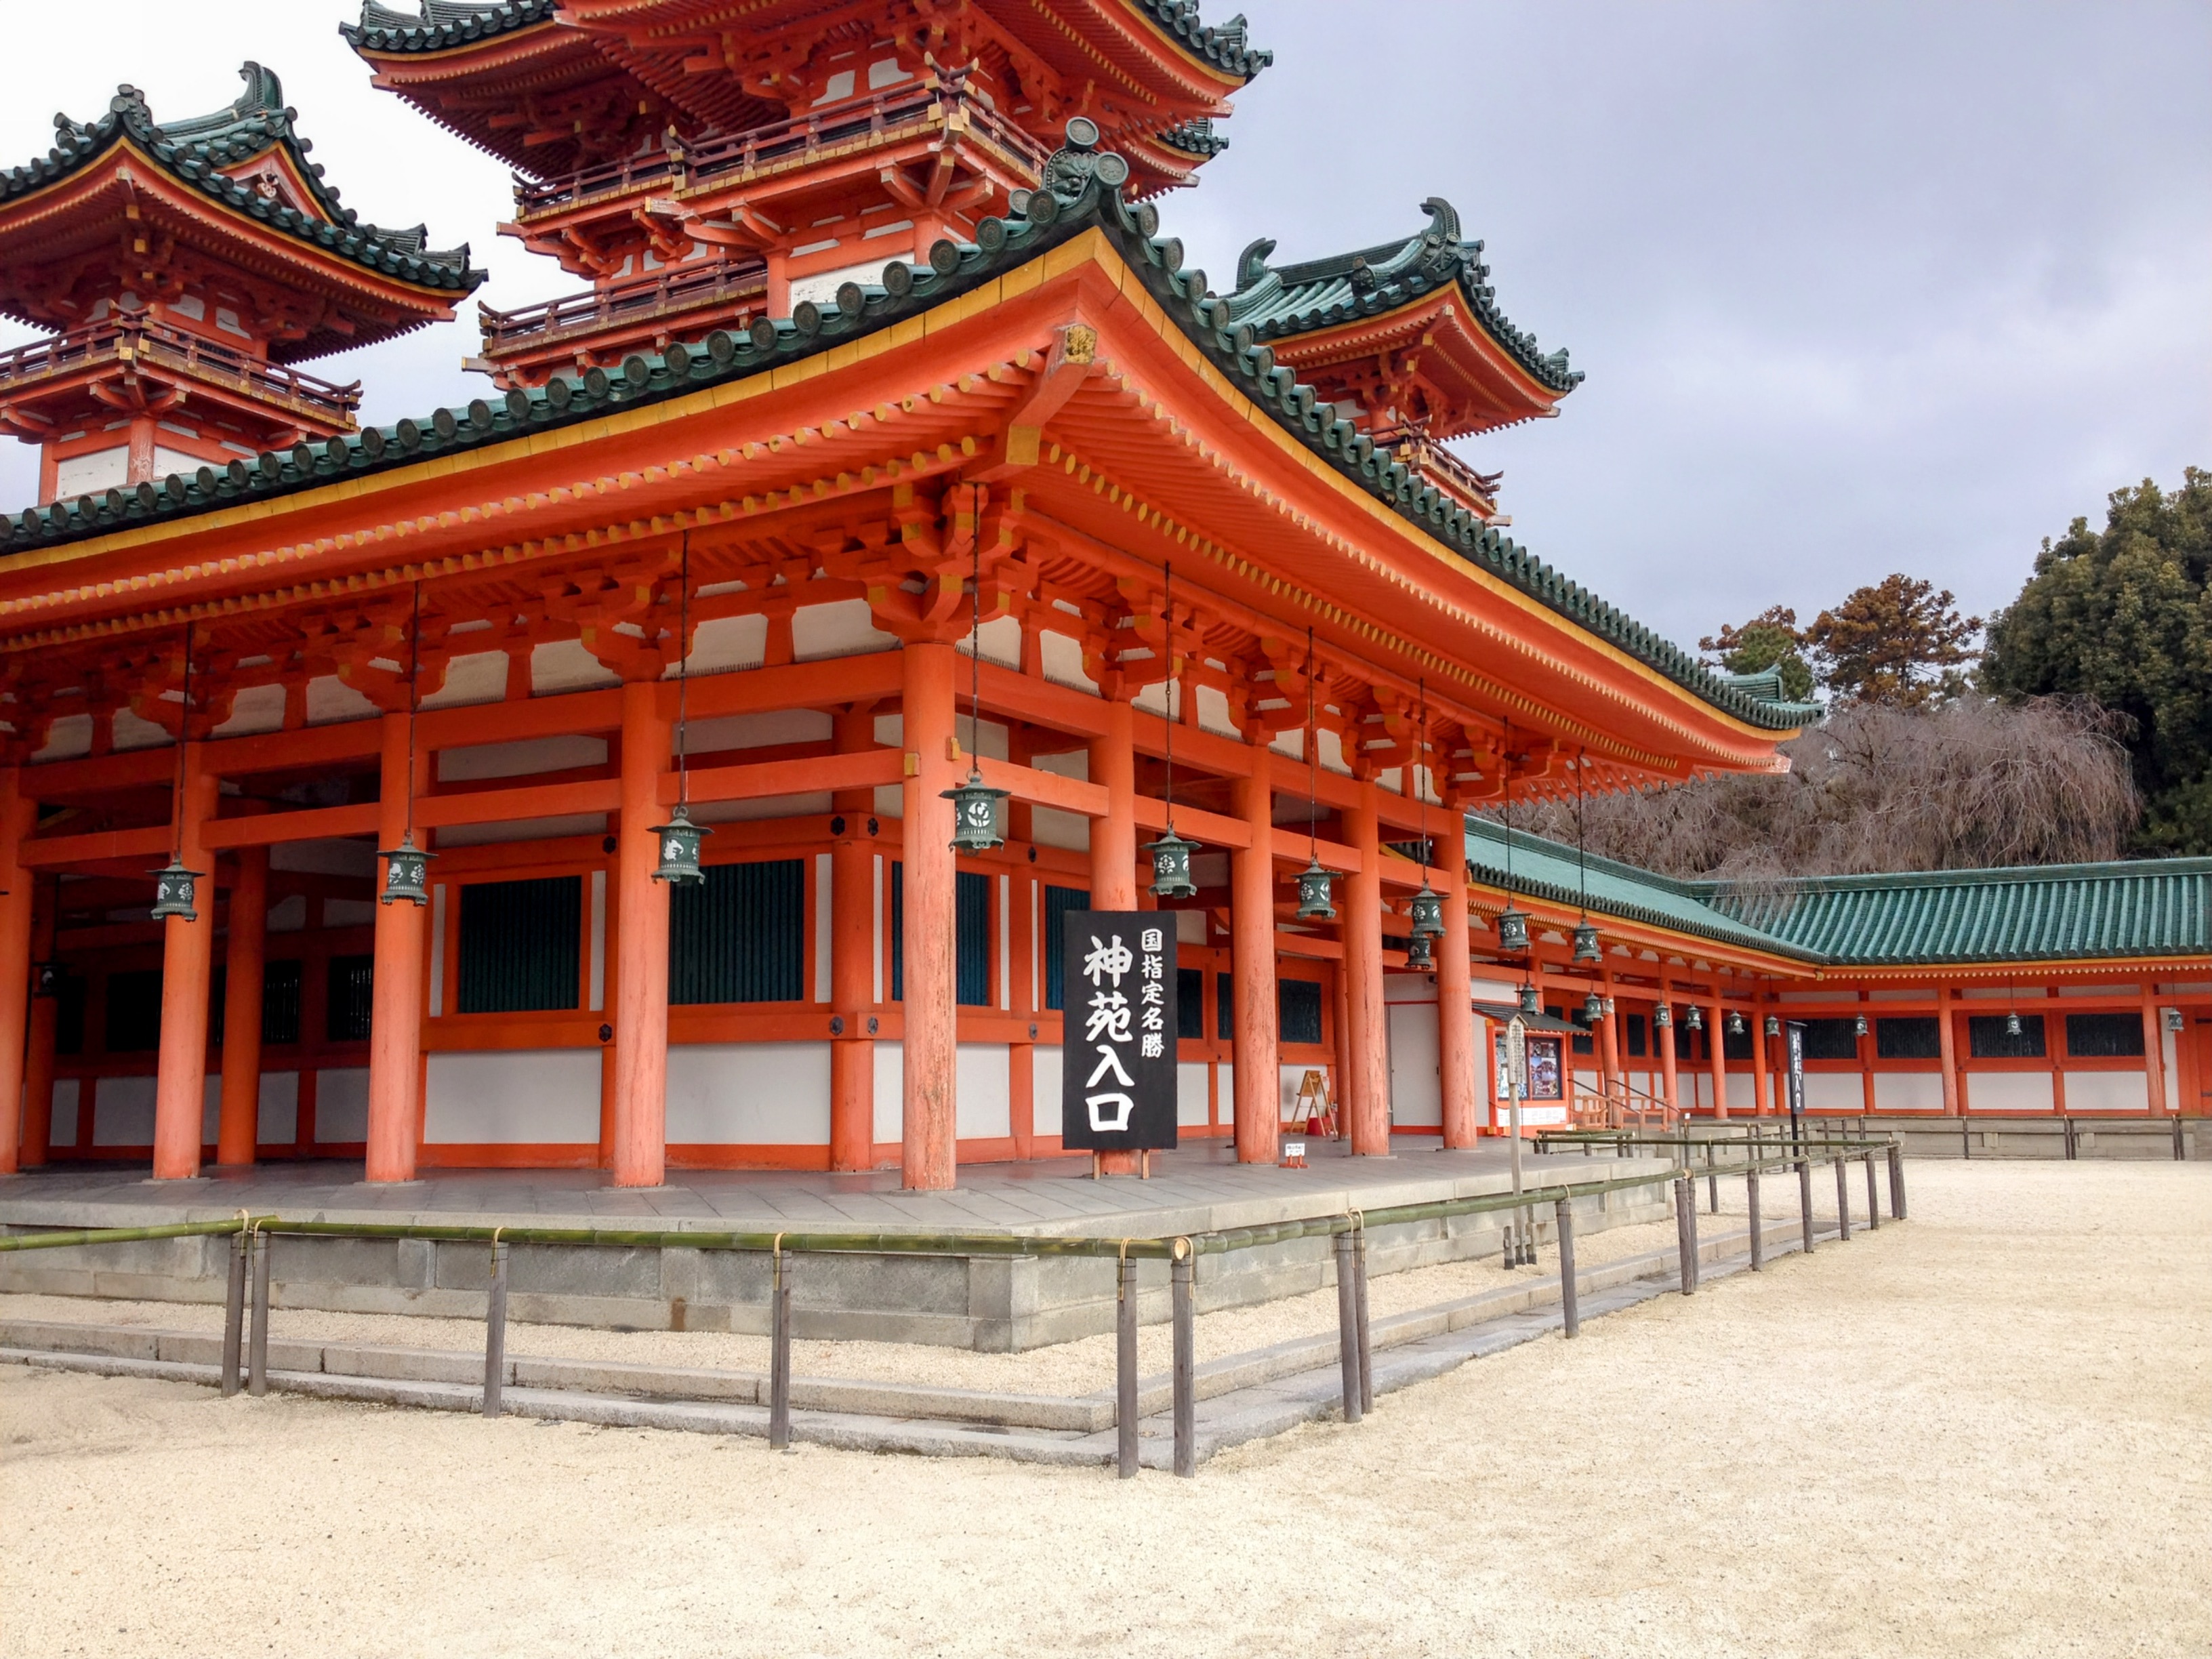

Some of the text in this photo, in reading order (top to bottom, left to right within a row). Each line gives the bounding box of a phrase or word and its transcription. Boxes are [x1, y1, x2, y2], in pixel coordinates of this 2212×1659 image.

[1083, 935, 1135, 1132] 神苑入口
[1141, 928, 1165, 1059] 国指定名勝
